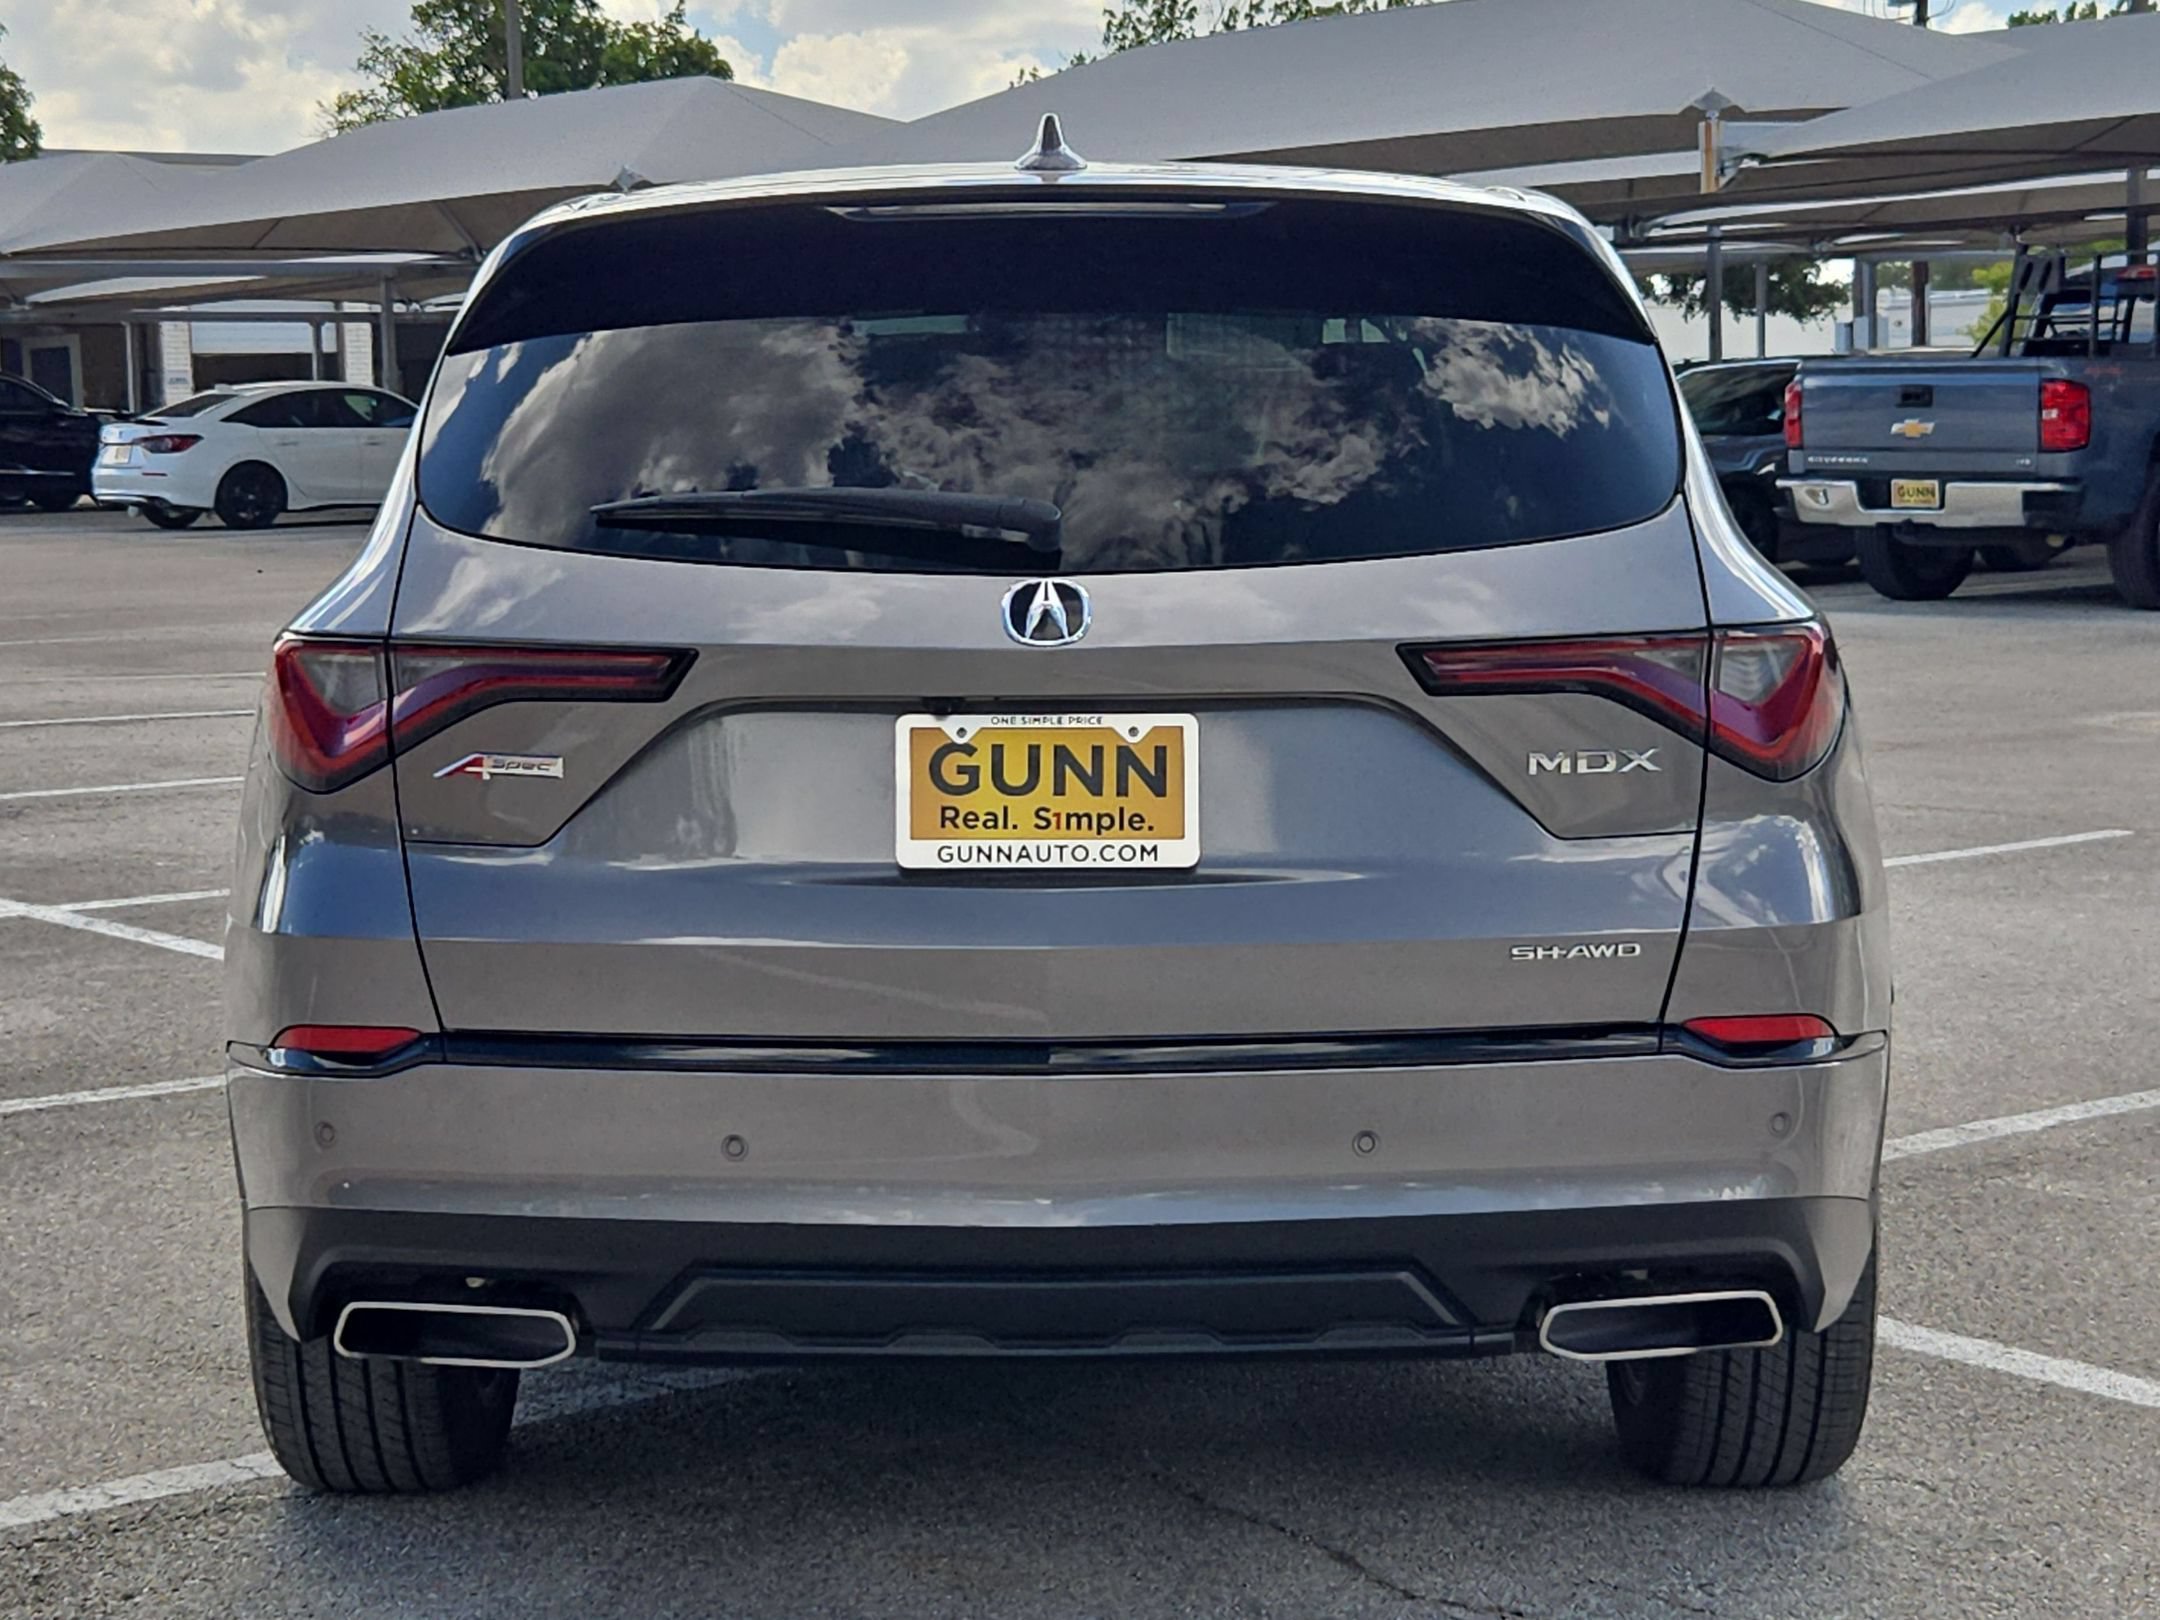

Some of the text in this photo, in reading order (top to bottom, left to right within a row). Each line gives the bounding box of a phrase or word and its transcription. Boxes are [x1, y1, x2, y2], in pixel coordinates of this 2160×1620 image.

[990, 716, 1103, 726] ONE SIMPLE PRICE
[929, 743, 1167, 798] GUNN
[1527, 748, 1663, 776] MDX
[940, 806, 1019, 831] Real.
[937, 844, 1159, 864] GUNNAUTO.COM
[1511, 942, 1642, 960] SH-AWD
